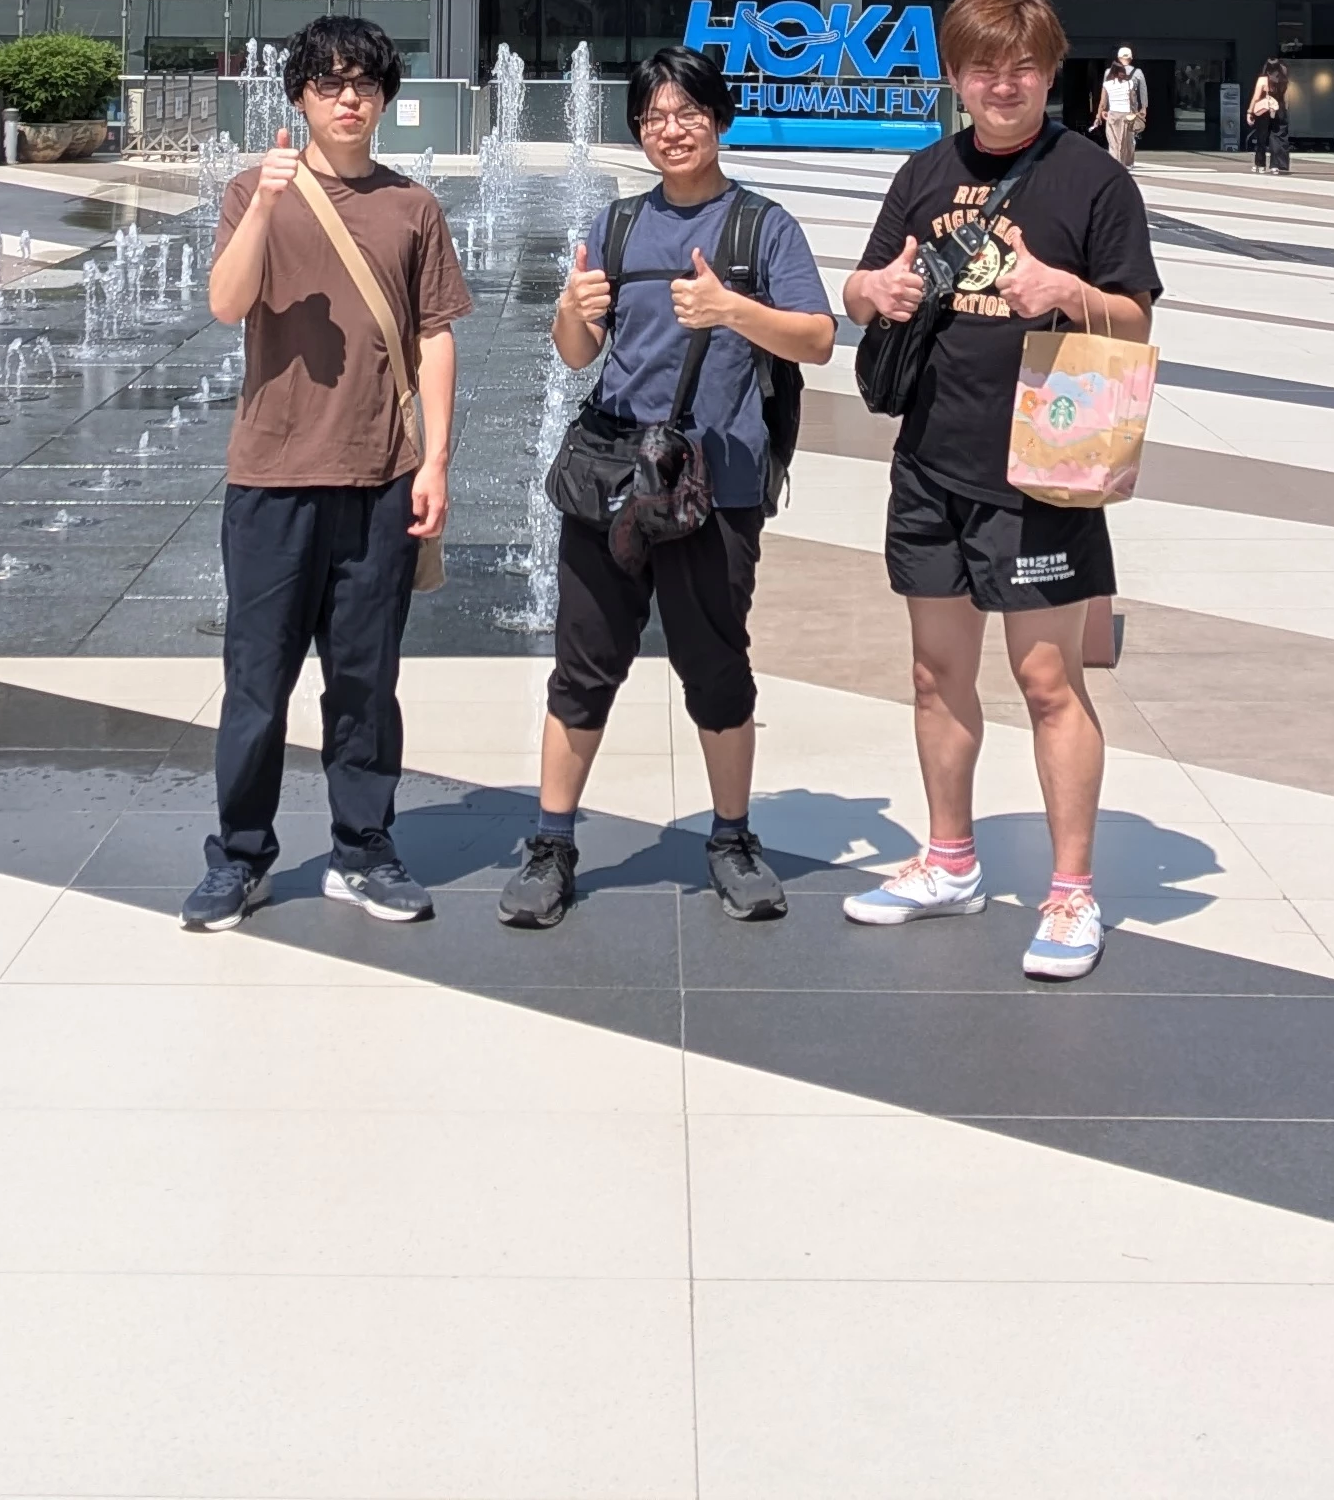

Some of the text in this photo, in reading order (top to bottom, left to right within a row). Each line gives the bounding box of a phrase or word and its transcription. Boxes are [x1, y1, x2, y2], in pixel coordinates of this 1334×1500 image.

[683, 0, 941, 81] HOKA
[741, 83, 940, 116] HUMAN FLY
[1016, 551, 1067, 568] RIZIN
